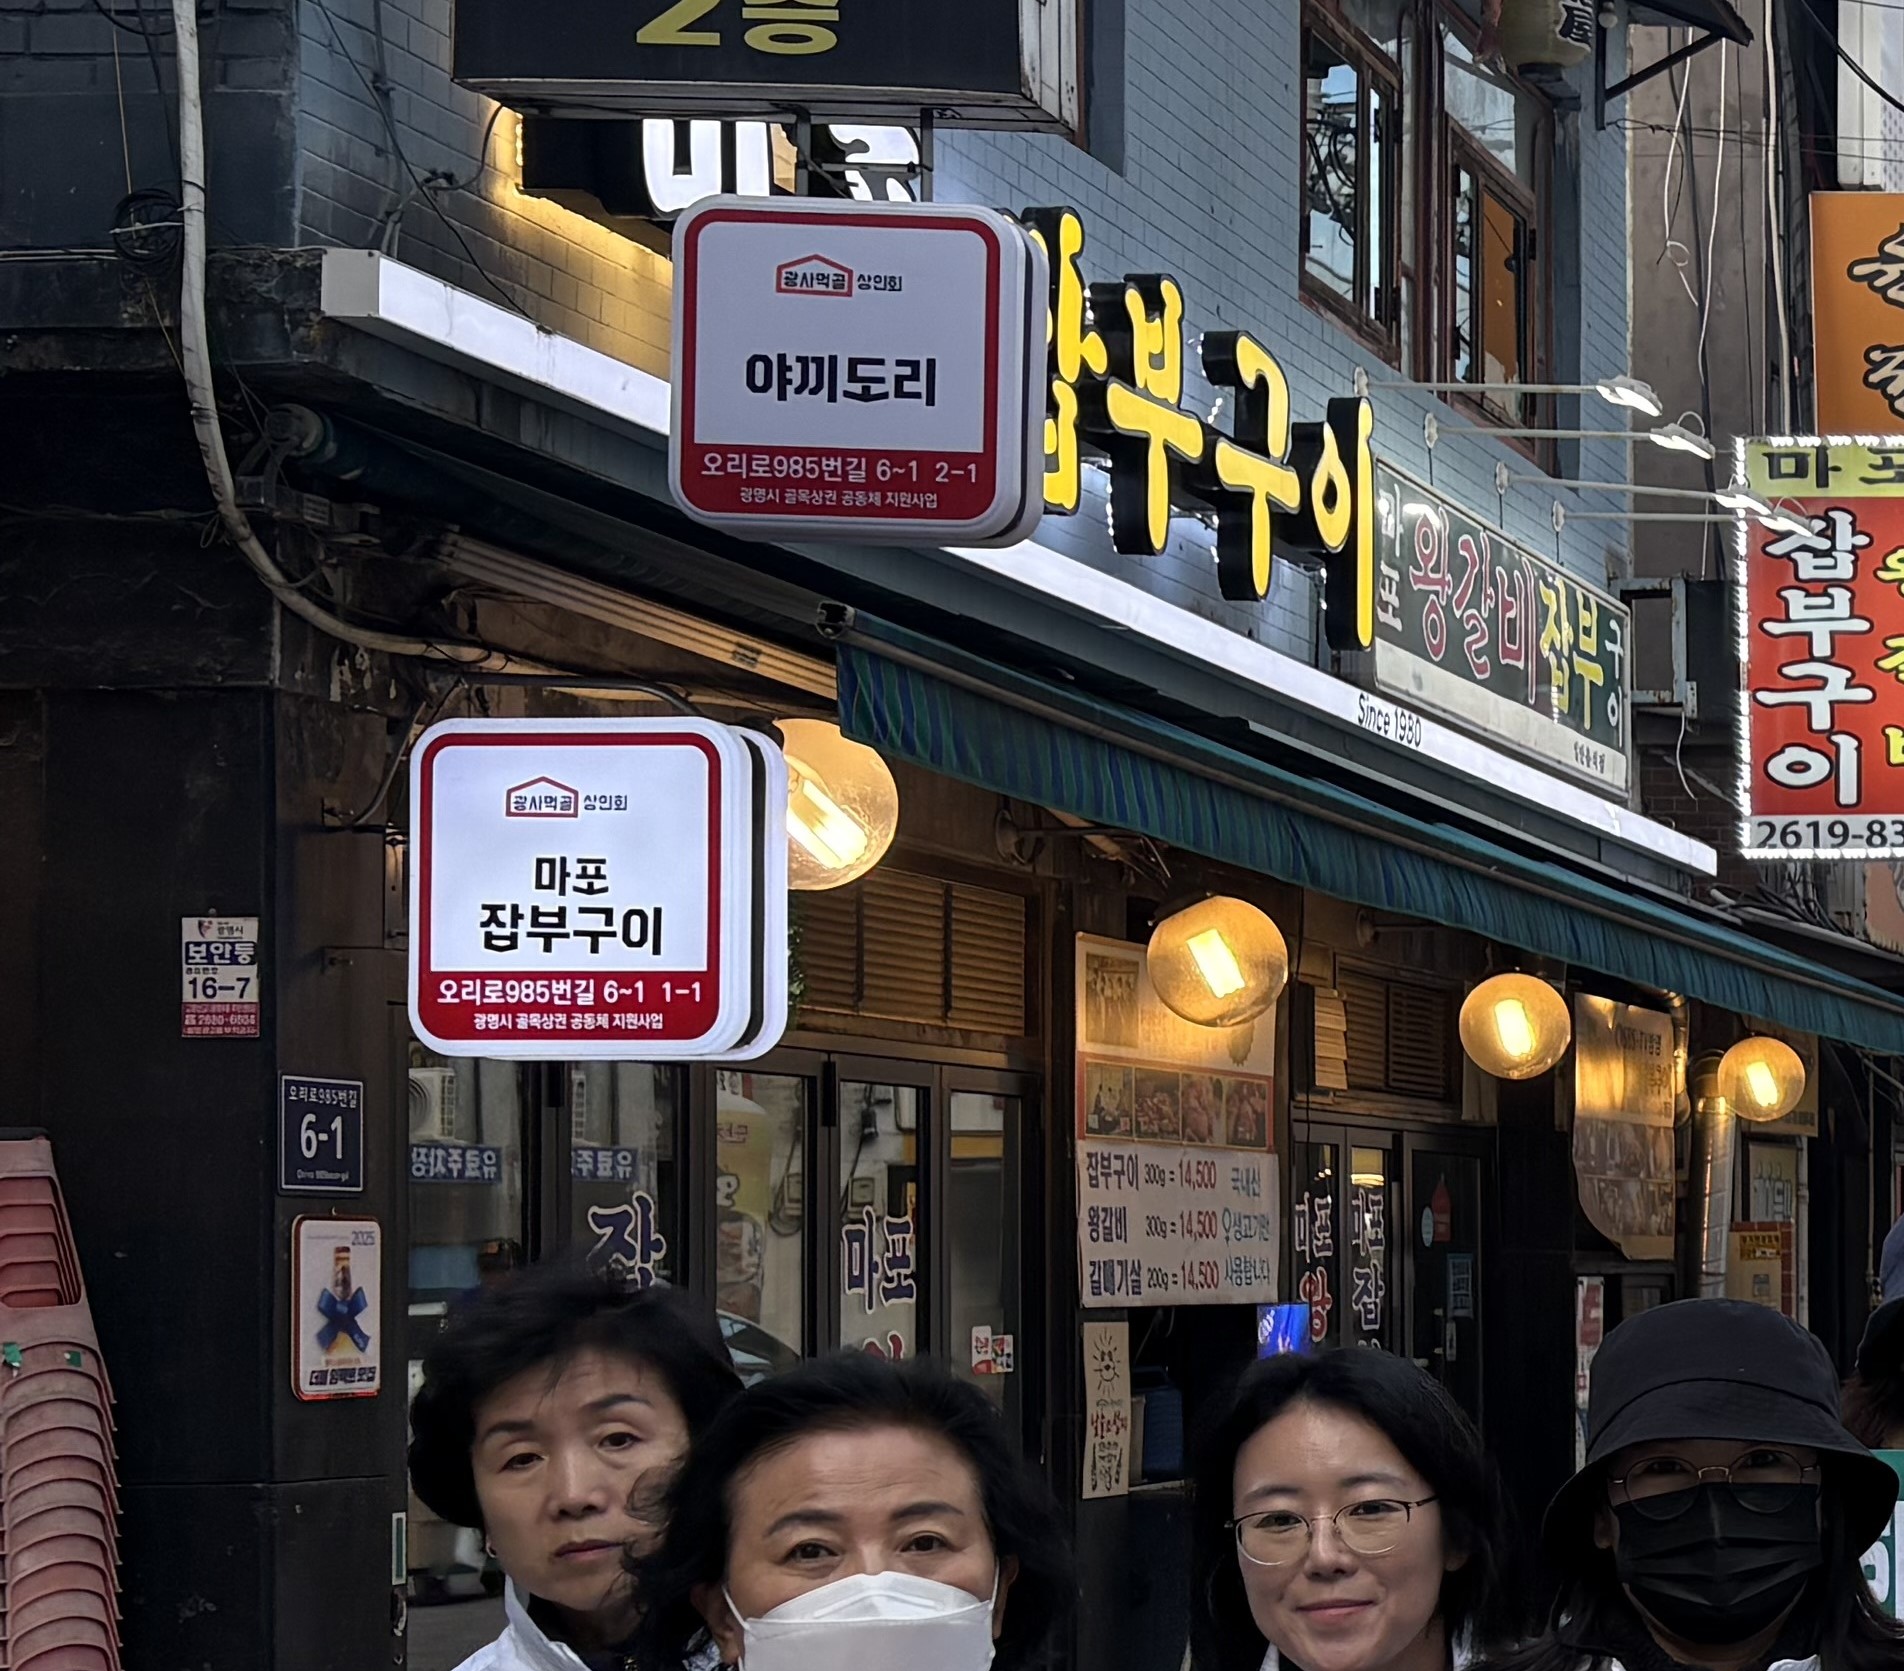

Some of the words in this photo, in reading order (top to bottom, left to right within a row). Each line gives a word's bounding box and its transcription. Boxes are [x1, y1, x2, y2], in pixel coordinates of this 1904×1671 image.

[857, 272, 904, 293] 상인회
[745, 352, 938, 407] 야끼도리
[701, 452, 868, 484] 오리로985번길
[935, 462, 978, 484] 2-1
[739, 487, 780, 505] 광명시
[784, 489, 839, 507] 골목상권
[841, 491, 881, 507] 공동체
[885, 492, 938, 509] 지원사업
[1409, 502, 1538, 705] 왕갈비
[1753, 507, 1876, 808] 잡부구이
[1358, 692, 1391, 736] Since
[1394, 708, 1422, 748] 1980
[583, 795, 628, 812] 상인회
[534, 856, 609, 897] 마포
[479, 903, 663, 956] 잡부구이
[187, 942, 255, 965] 보안등
[188, 977, 251, 999] 16-7
[436, 979, 596, 1006] 오리로985번길
[661, 981, 701, 1003] 1-1
[473, 1013, 513, 1029] 광명시
[515, 1013, 568, 1030] 골목상권
[570, 1013, 609, 1029] 공동체
[612, 1013, 664, 1030] 지원사업
[288, 1085, 358, 1109] 오리로985번길
[300, 1113, 343, 1160] 6-1
[1086, 1151, 1140, 1191] 잡부구이
[1144, 1163, 1167, 1188] 300g
[1178, 1159, 1218, 1190] 14,500
[1087, 1205, 1128, 1243] 왕갈비
[1179, 1209, 1218, 1242] 14,500
[1179, 1260, 1220, 1292] 14,500
